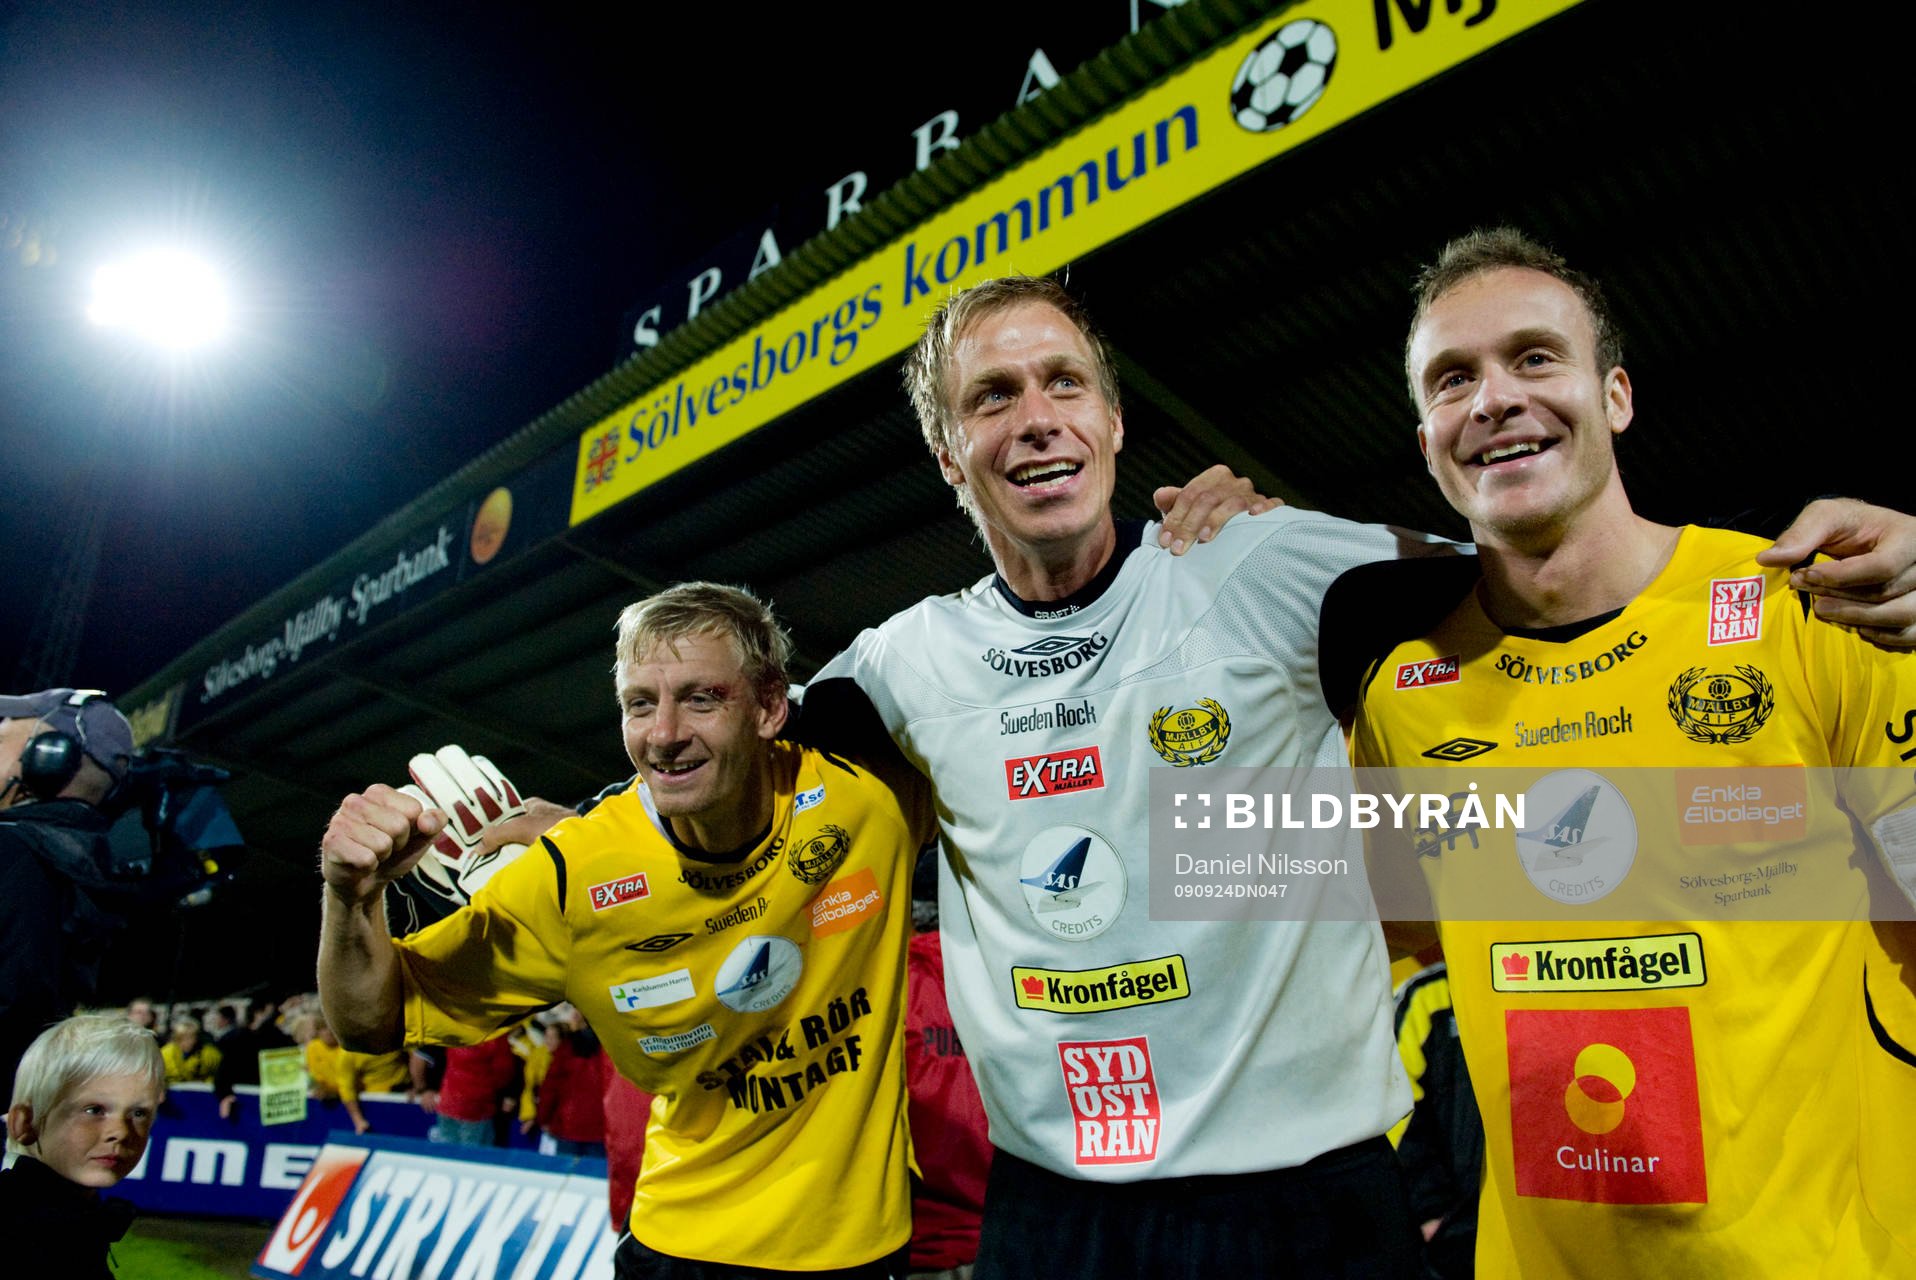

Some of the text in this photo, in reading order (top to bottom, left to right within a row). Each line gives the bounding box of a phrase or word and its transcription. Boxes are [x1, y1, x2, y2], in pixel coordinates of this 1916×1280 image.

[625, 104, 1199, 464] Sölvesborgs kommun
[347, 526, 453, 625] Sparbank
[1715, 581, 1760, 603] SYD
[1034, 607, 1070, 619] CRAFT
[1712, 618, 1757, 641] RAN
[982, 631, 1108, 678] SÖLVESBORG
[1495, 631, 1648, 685] SÖLVESBORG
[1001, 700, 1096, 735] Sweden Rock
[1515, 706, 1633, 748] Sweden Rock
[1691, 784, 1761, 803] Enkla
[1684, 802, 1803, 824] Elbolaget
[1548, 824, 1582, 845] SAS
[678, 836, 785, 890] SÖLVESBORG
[1680, 862, 1798, 889] Sölvesborg-Mjällby
[1043, 872, 1078, 890] SAS
[1549, 875, 1605, 897] CREDITS
[1714, 883, 1772, 906] Sparbank
[812, 889, 852, 915] Enkla
[812, 890, 879, 928] Elbolaget
[705, 904, 758, 935] Sweden
[1052, 914, 1103, 935] CREDITS
[1535, 943, 1692, 984] Kronfågel
[1047, 964, 1178, 1005] Kronfågel
[776, 1029, 796, 1060] &
[800, 987, 872, 1050] RÖR
[1063, 1045, 1147, 1084] SYD
[1079, 1119, 1157, 1157] RAN
[1556, 1145, 1660, 1174] Culinar
